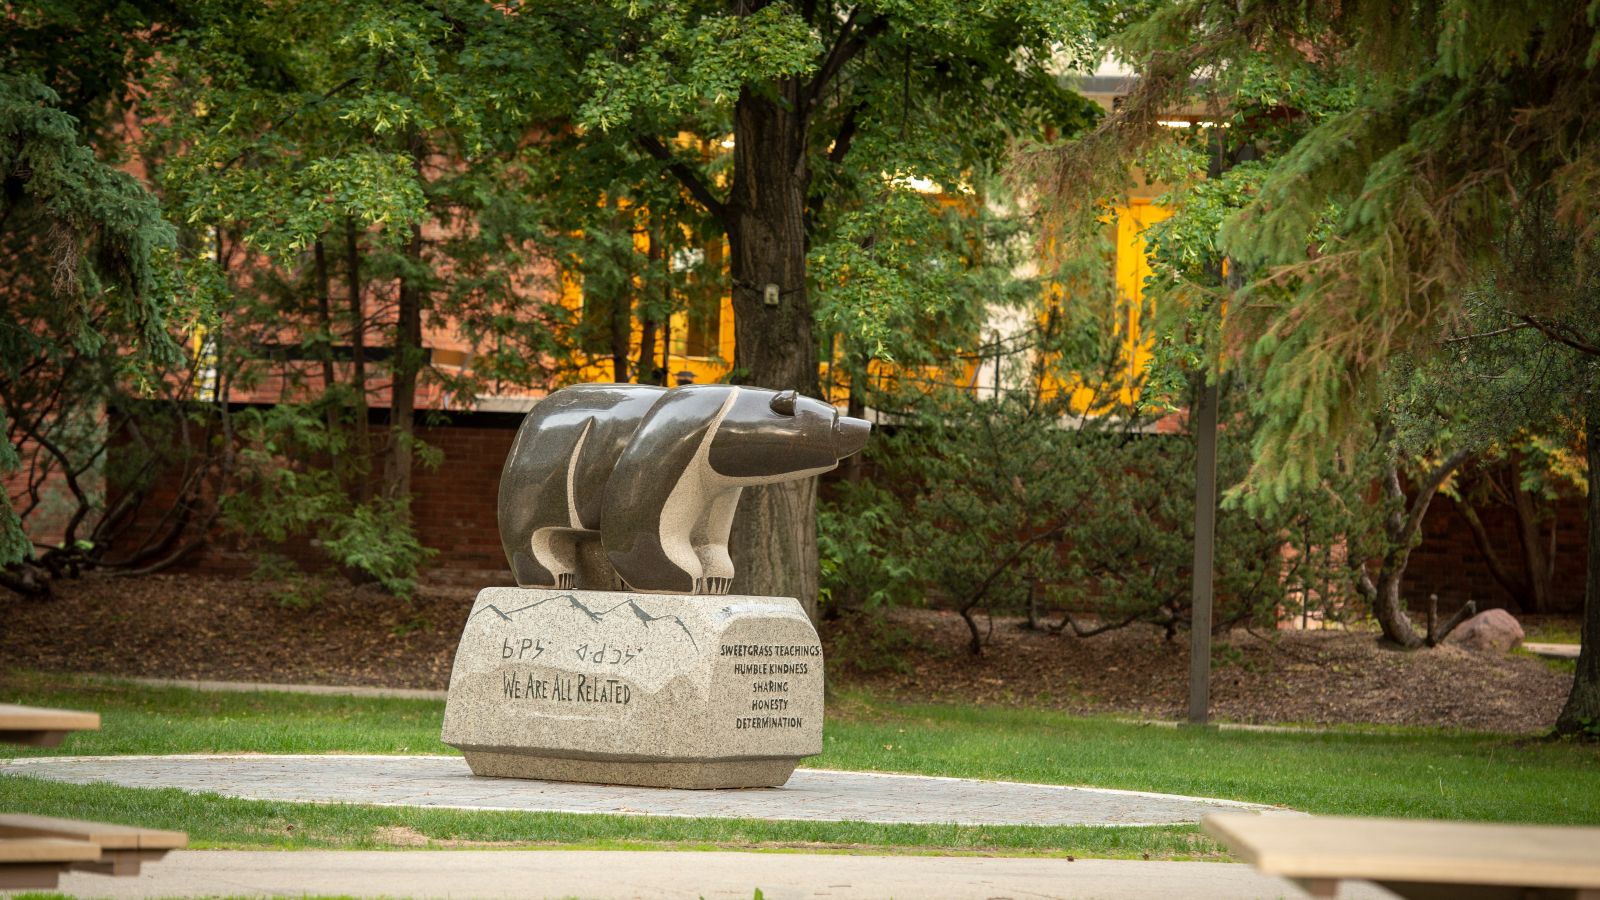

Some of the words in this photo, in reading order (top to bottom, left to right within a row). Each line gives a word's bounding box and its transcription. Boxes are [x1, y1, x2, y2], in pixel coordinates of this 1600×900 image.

[720, 644, 773, 657] SWEETGRASS
[775, 645, 822, 657] TEACHINGS:
[734, 663, 767, 675] HUMBLE
[769, 663, 808, 675] KINDNESS
[503, 671, 521, 699] WE
[525, 672, 548, 699] ARE
[552, 673, 573, 702] ALL
[752, 681, 789, 693] SHARING
[751, 698, 788, 711] HONESTY
[736, 717, 803, 729] DETERMINATION
